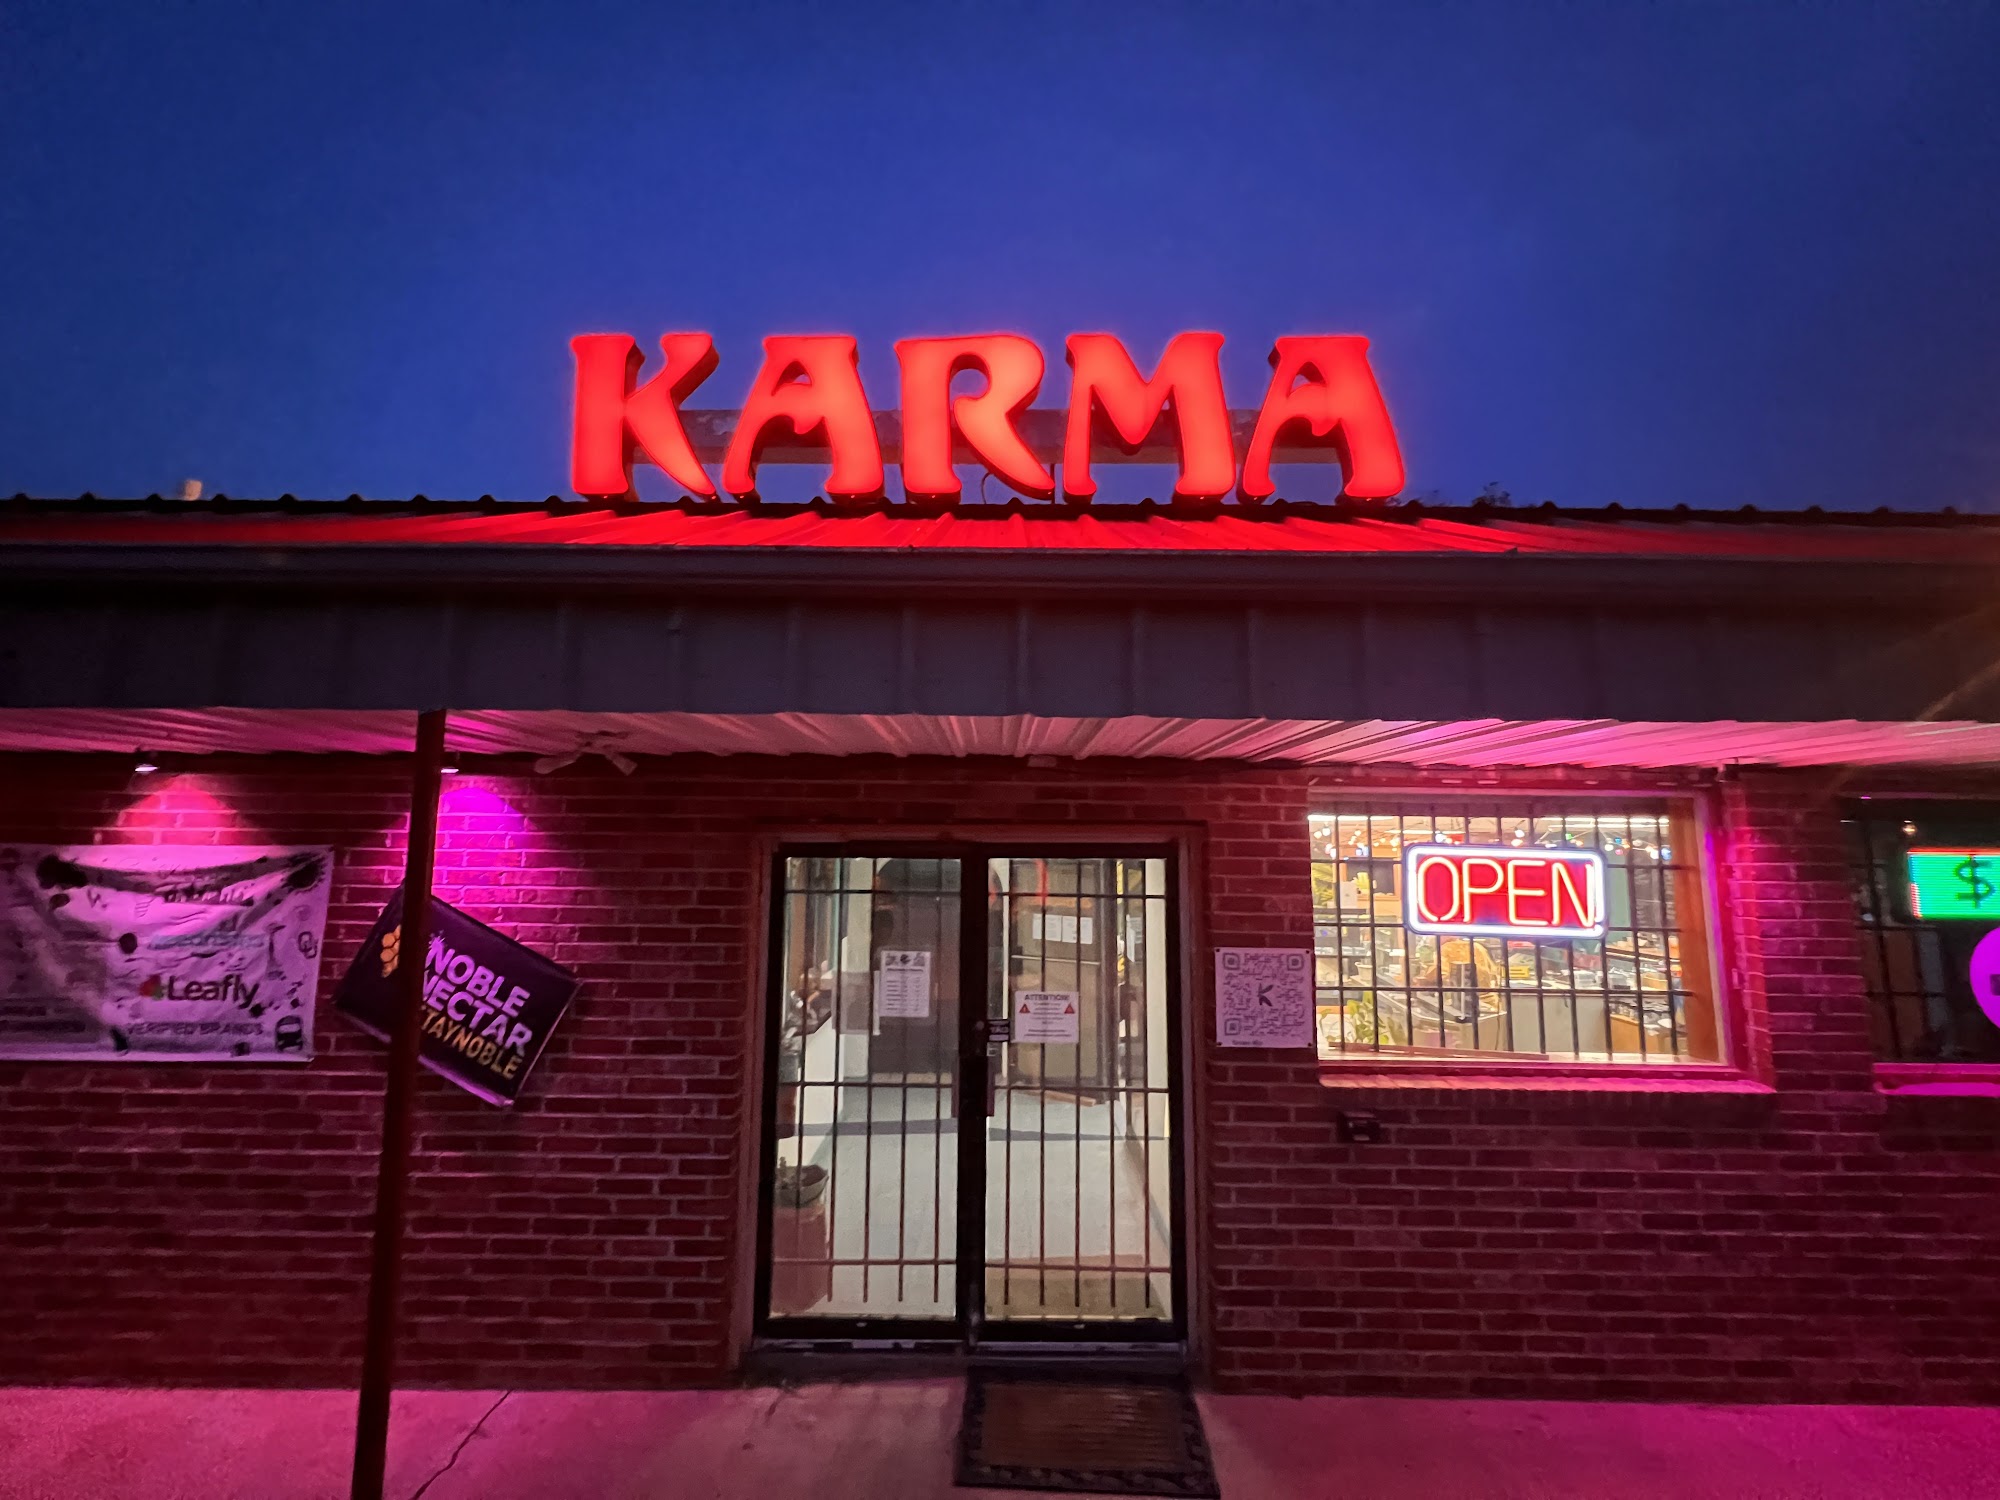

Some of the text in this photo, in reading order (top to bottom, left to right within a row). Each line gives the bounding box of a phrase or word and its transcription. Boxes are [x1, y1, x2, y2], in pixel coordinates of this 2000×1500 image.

[570, 331, 1405, 502] KARMA
[1416, 855, 1597, 929] OPEN
[168, 974, 260, 1009] Leafly
[423, 969, 533, 1057] NECTAR
[425, 936, 530, 1017] NOBLE
[421, 1004, 523, 1080] TAYNOBLE
